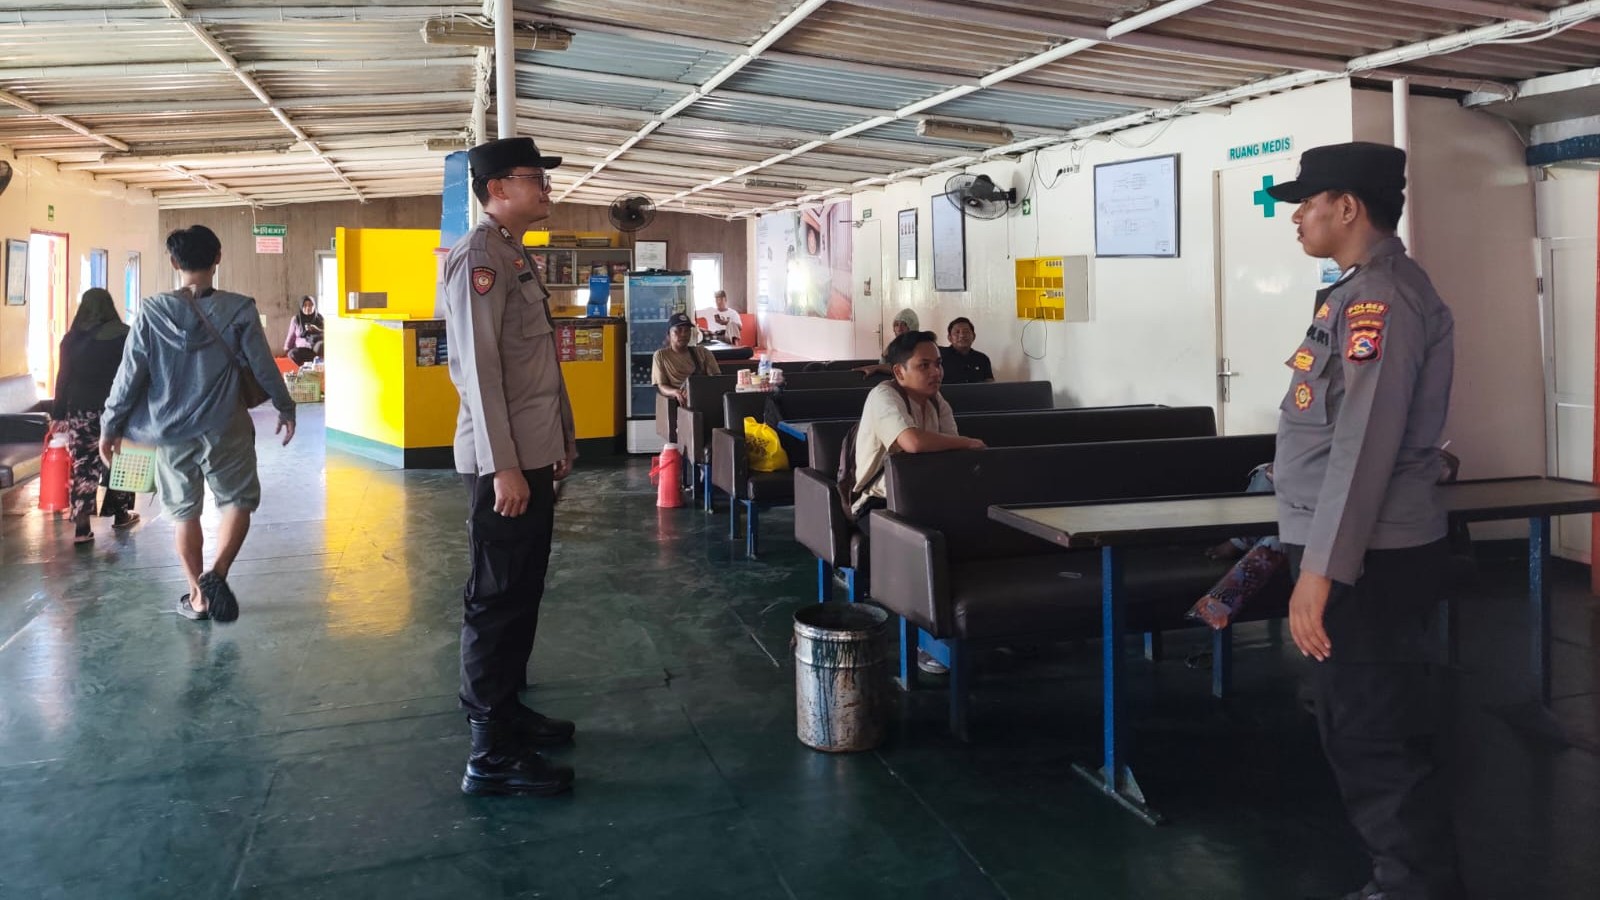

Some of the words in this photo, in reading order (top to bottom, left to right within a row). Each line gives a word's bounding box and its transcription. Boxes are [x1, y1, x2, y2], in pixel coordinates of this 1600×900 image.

[1229, 143, 1259, 160] RUANG
[1261, 137, 1290, 154] MEDIS
[1348, 302, 1385, 313] POLRES
